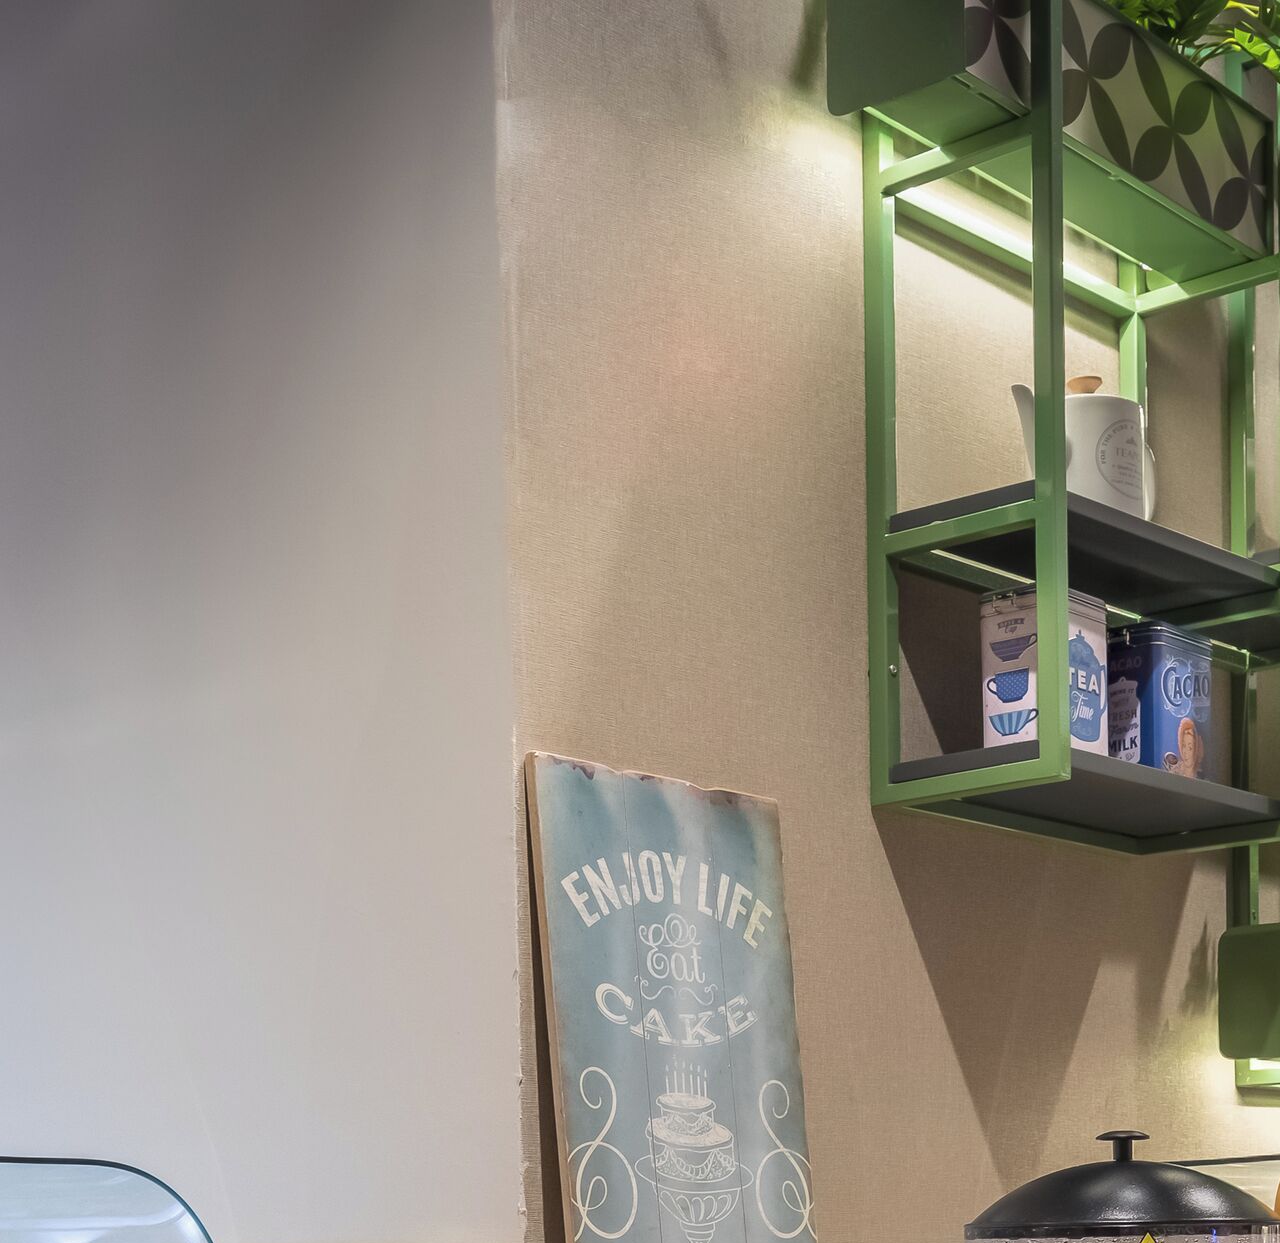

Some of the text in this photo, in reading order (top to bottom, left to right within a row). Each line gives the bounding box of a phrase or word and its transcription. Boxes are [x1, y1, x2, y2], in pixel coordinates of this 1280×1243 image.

[1108, 655, 1142, 673] ACAO
[1161, 664, 1211, 708] CACAO
[560, 849, 773, 950] ENJOY LIFE
[638, 912, 706, 984] Eat
[595, 982, 760, 1048] CAKE
